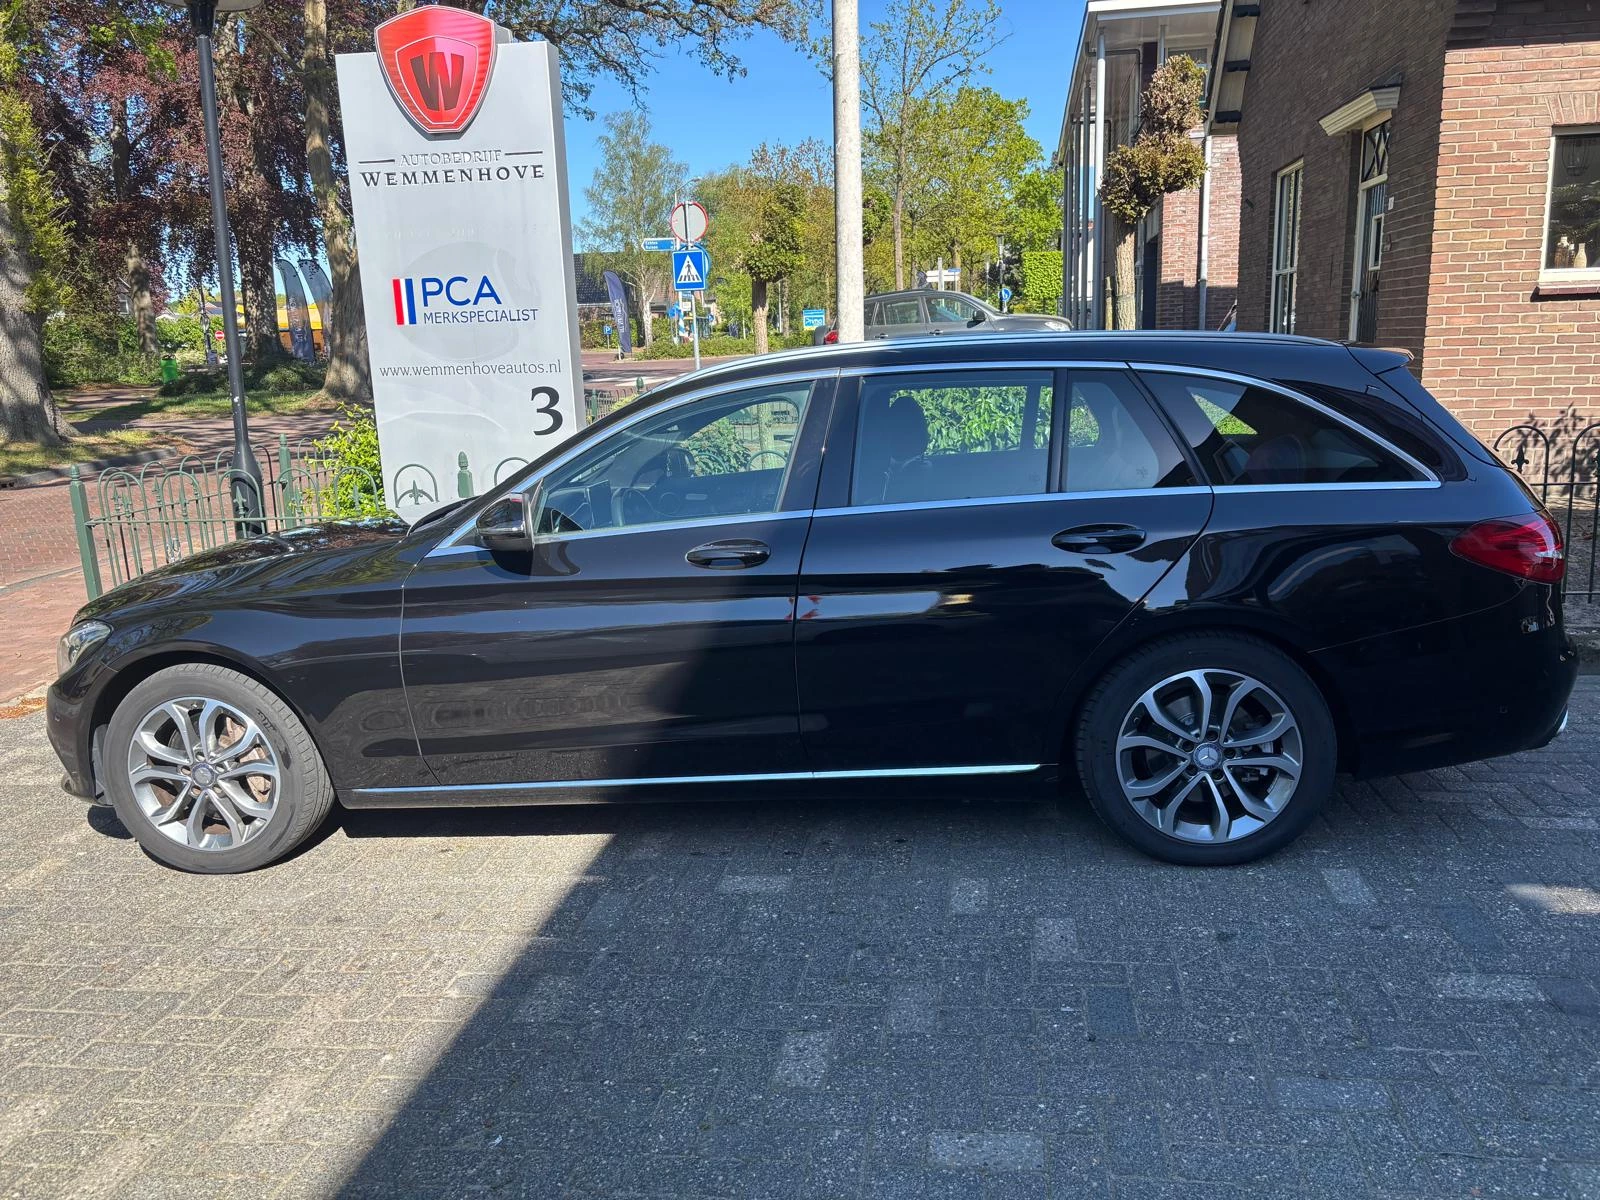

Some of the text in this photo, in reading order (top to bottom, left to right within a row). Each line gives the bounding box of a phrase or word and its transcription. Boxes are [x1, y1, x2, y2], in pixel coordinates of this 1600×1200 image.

[410, 51, 465, 111] W
[400, 150, 502, 167] AUTOBEDRIJF
[359, 164, 545, 187] WEMMENHOVE
[421, 275, 503, 307] PCA
[423, 309, 539, 324] MERKSPECIALIST
[379, 360, 562, 377] www.wemmenhoveautos.nl
[530, 386, 564, 436] 3
